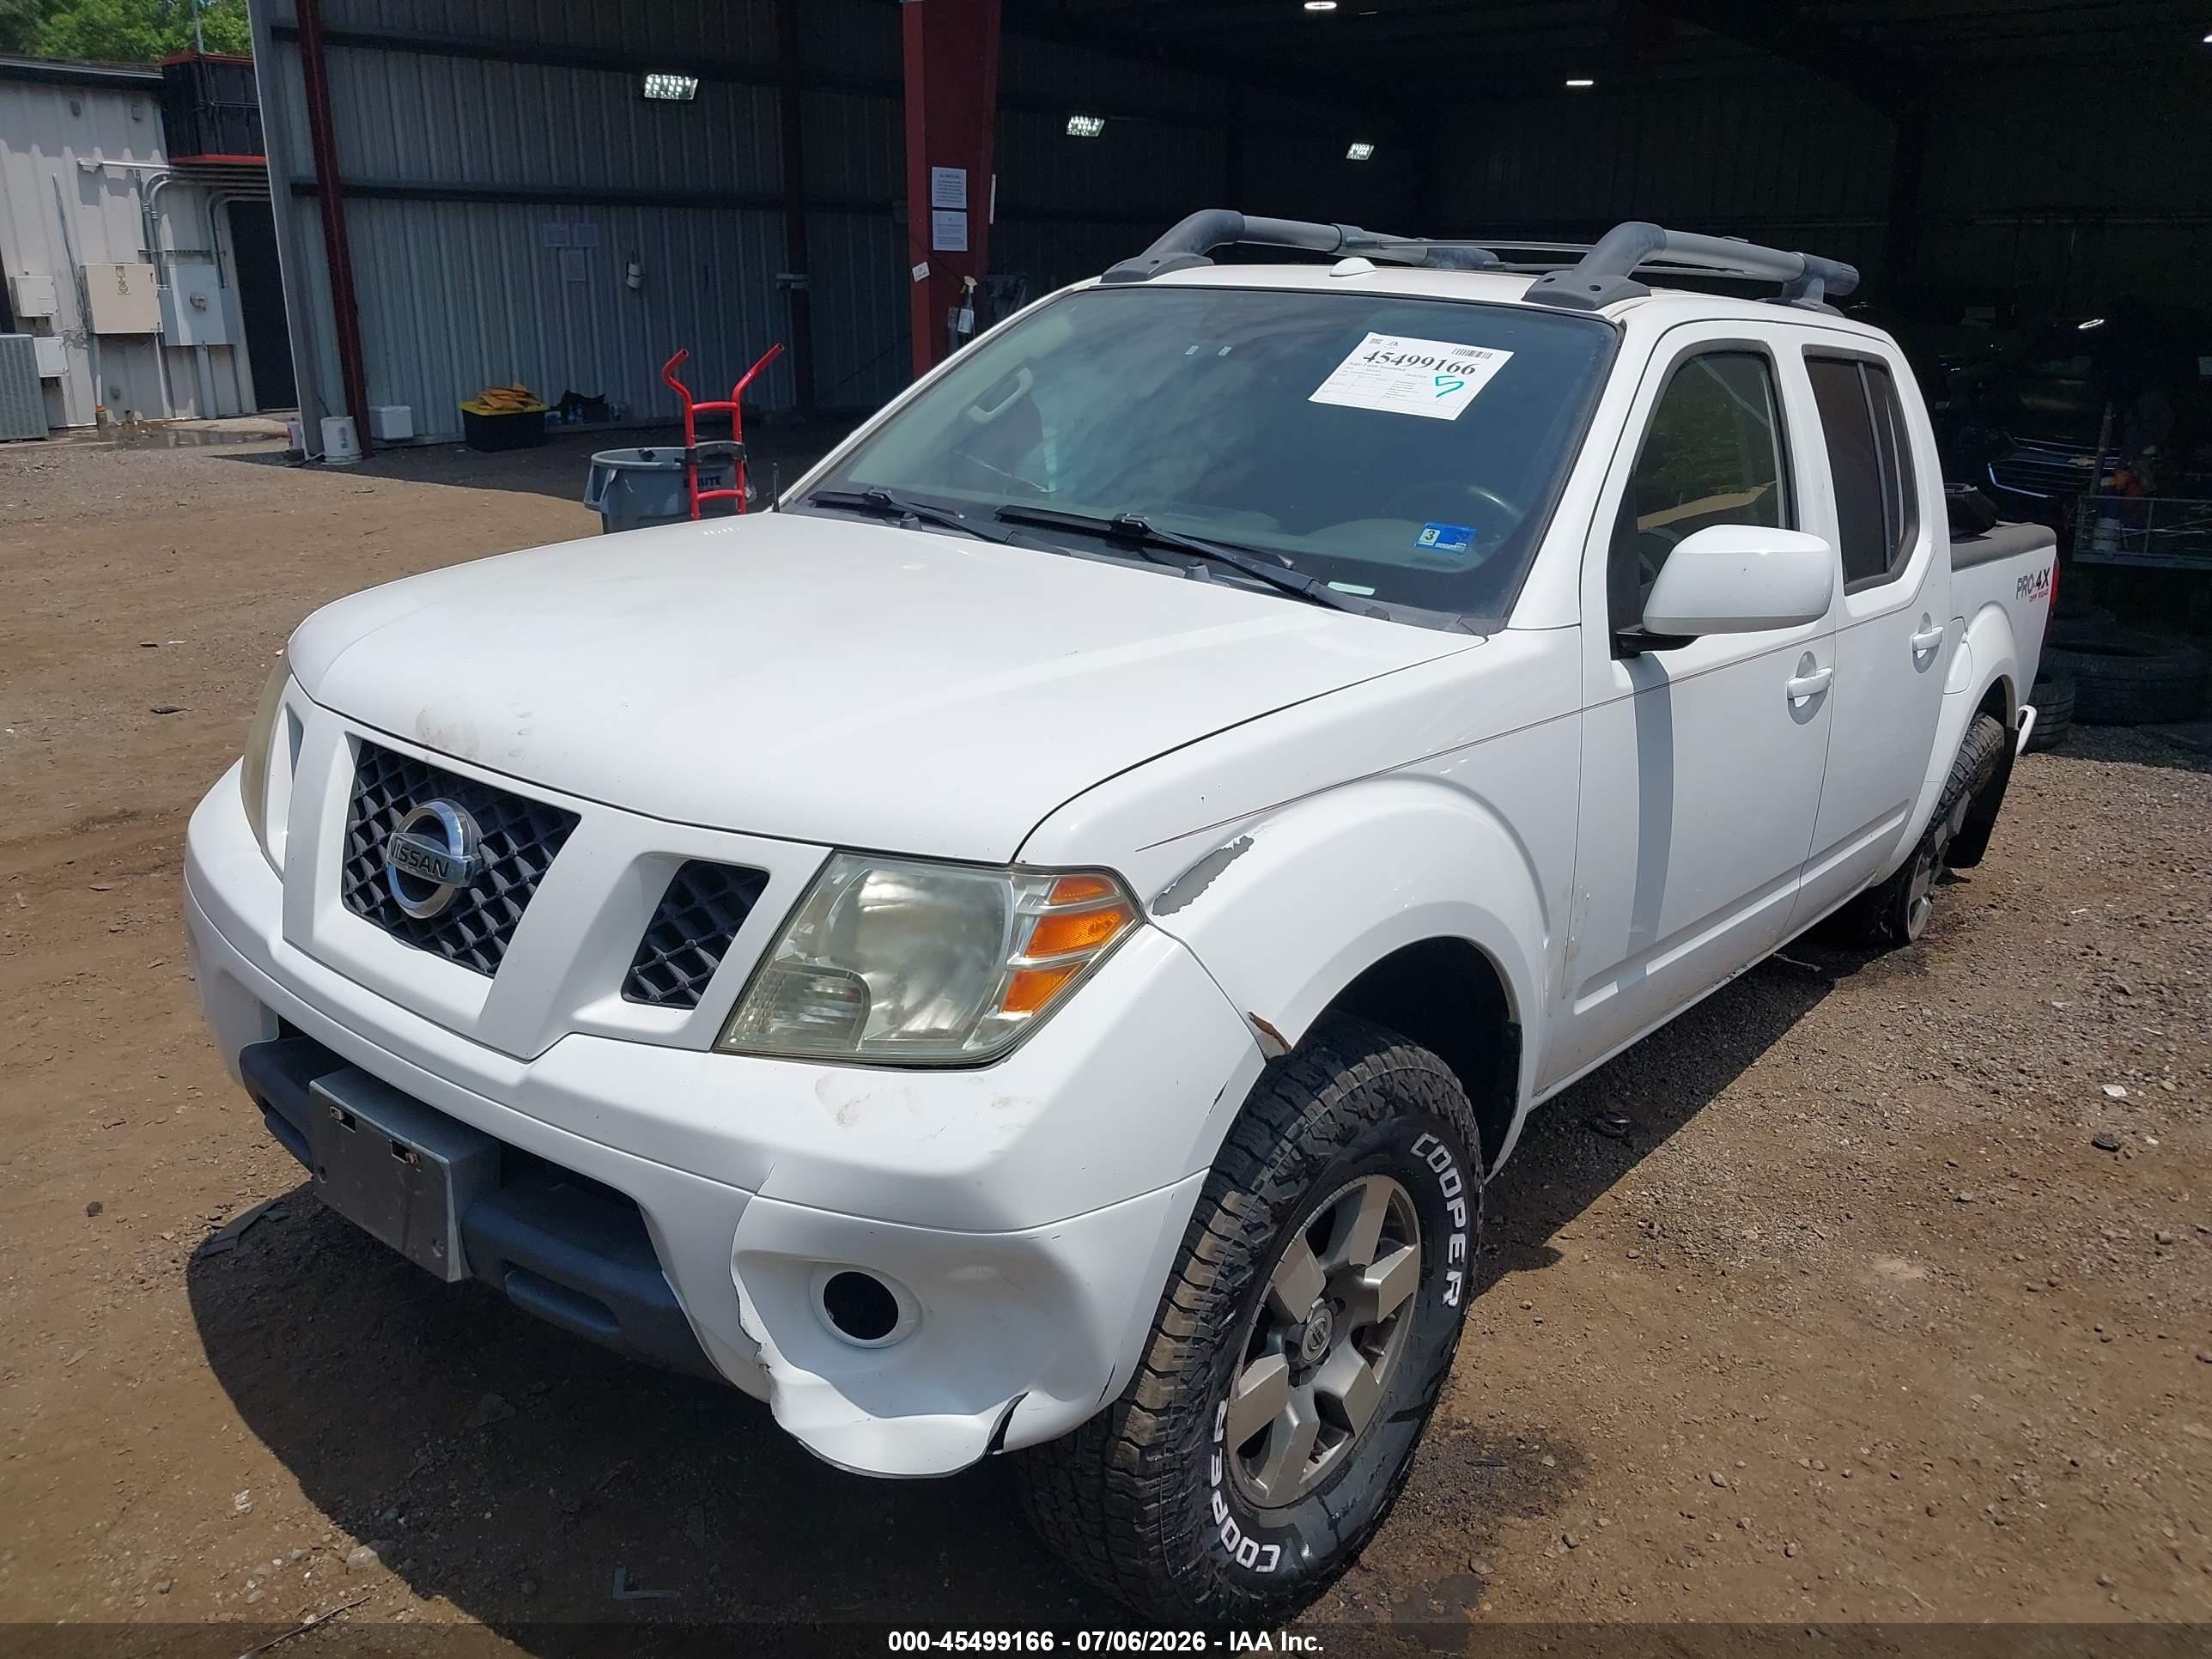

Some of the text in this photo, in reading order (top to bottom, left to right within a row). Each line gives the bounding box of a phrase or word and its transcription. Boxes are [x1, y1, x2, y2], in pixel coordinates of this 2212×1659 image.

[1363, 350, 1480, 375] 45499166
[1425, 530, 1435, 540] 3
[390, 837, 450, 878] NISSAN
[1410, 1133, 1467, 1307] COOPER
[1210, 1397, 1281, 1573] COOPER
